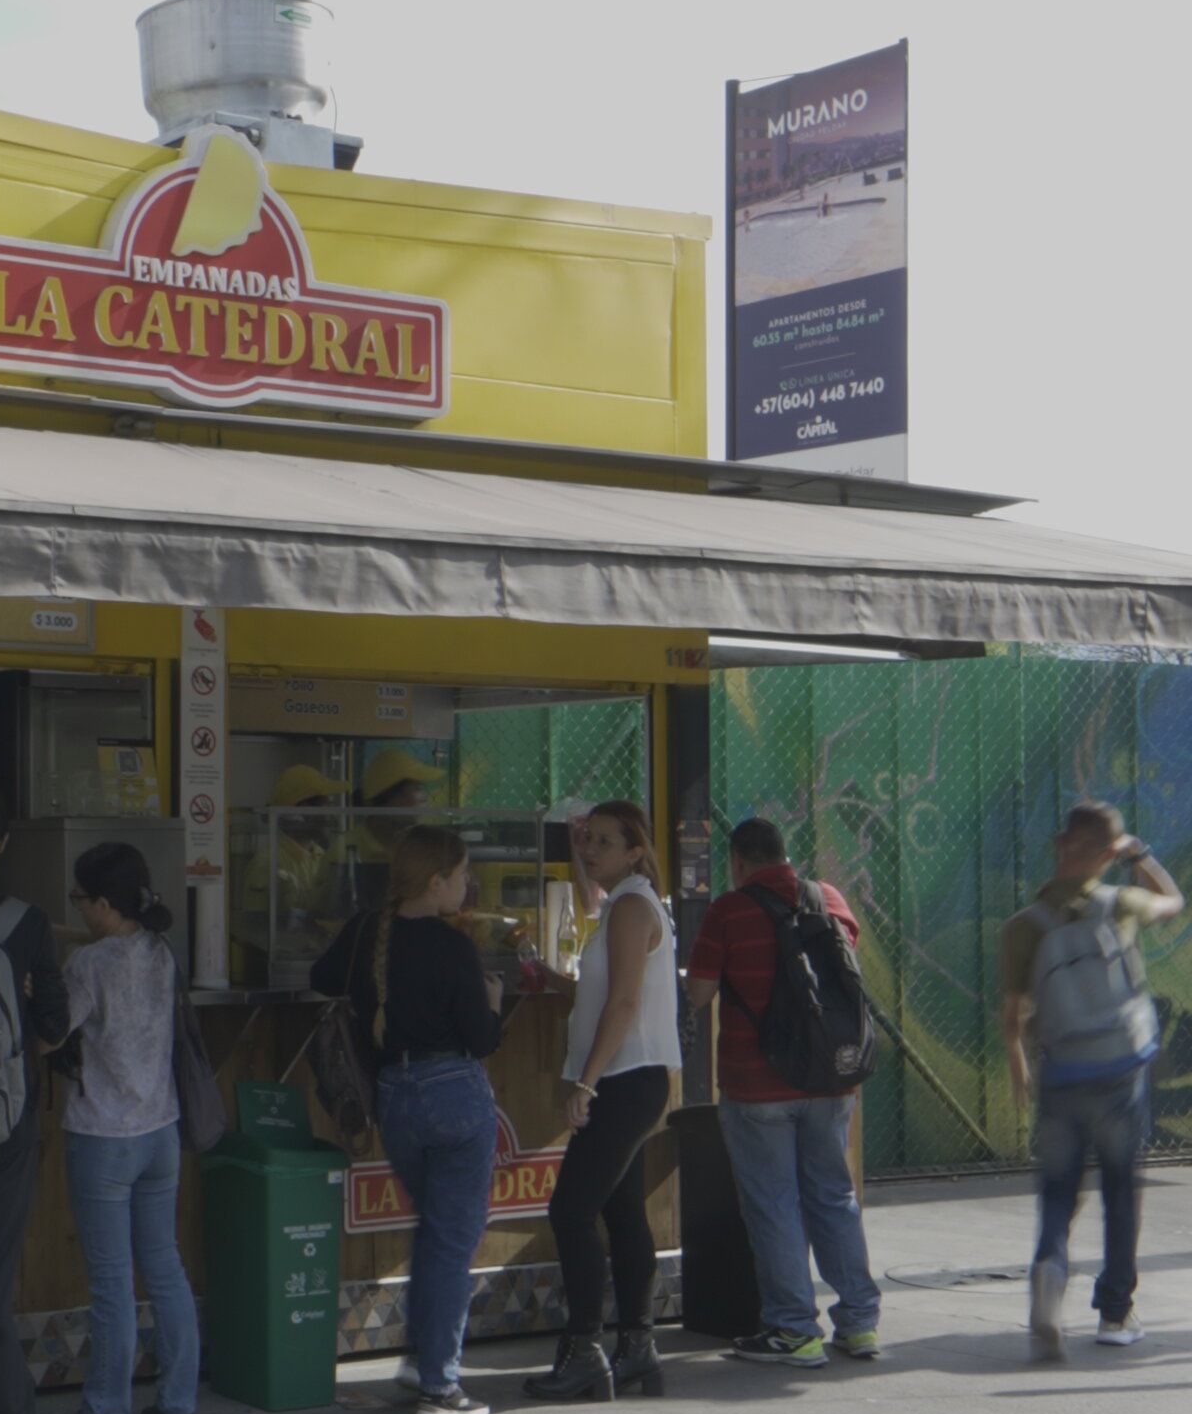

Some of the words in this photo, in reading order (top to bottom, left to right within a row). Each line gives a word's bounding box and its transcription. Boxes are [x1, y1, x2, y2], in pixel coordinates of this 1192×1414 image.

[767, 88, 868, 139] MURANO
[133, 255, 299, 302] EMPANADAS
[768, 306, 835, 328] APARTAMENTOS
[838, 299, 867, 314] DESDE
[802, 323, 833, 337] hasta
[836, 314, 864, 330] 84.84
[93, 284, 430, 384] CATEDRAL
[754, 388, 815, 414] +57(604)
[820, 384, 845, 403] 448
[850, 377, 885, 398] 7440
[796, 415, 838, 440] CAPITAL
[45, 615, 73, 628] 3.000
[359, 1178, 401, 1215] LA
